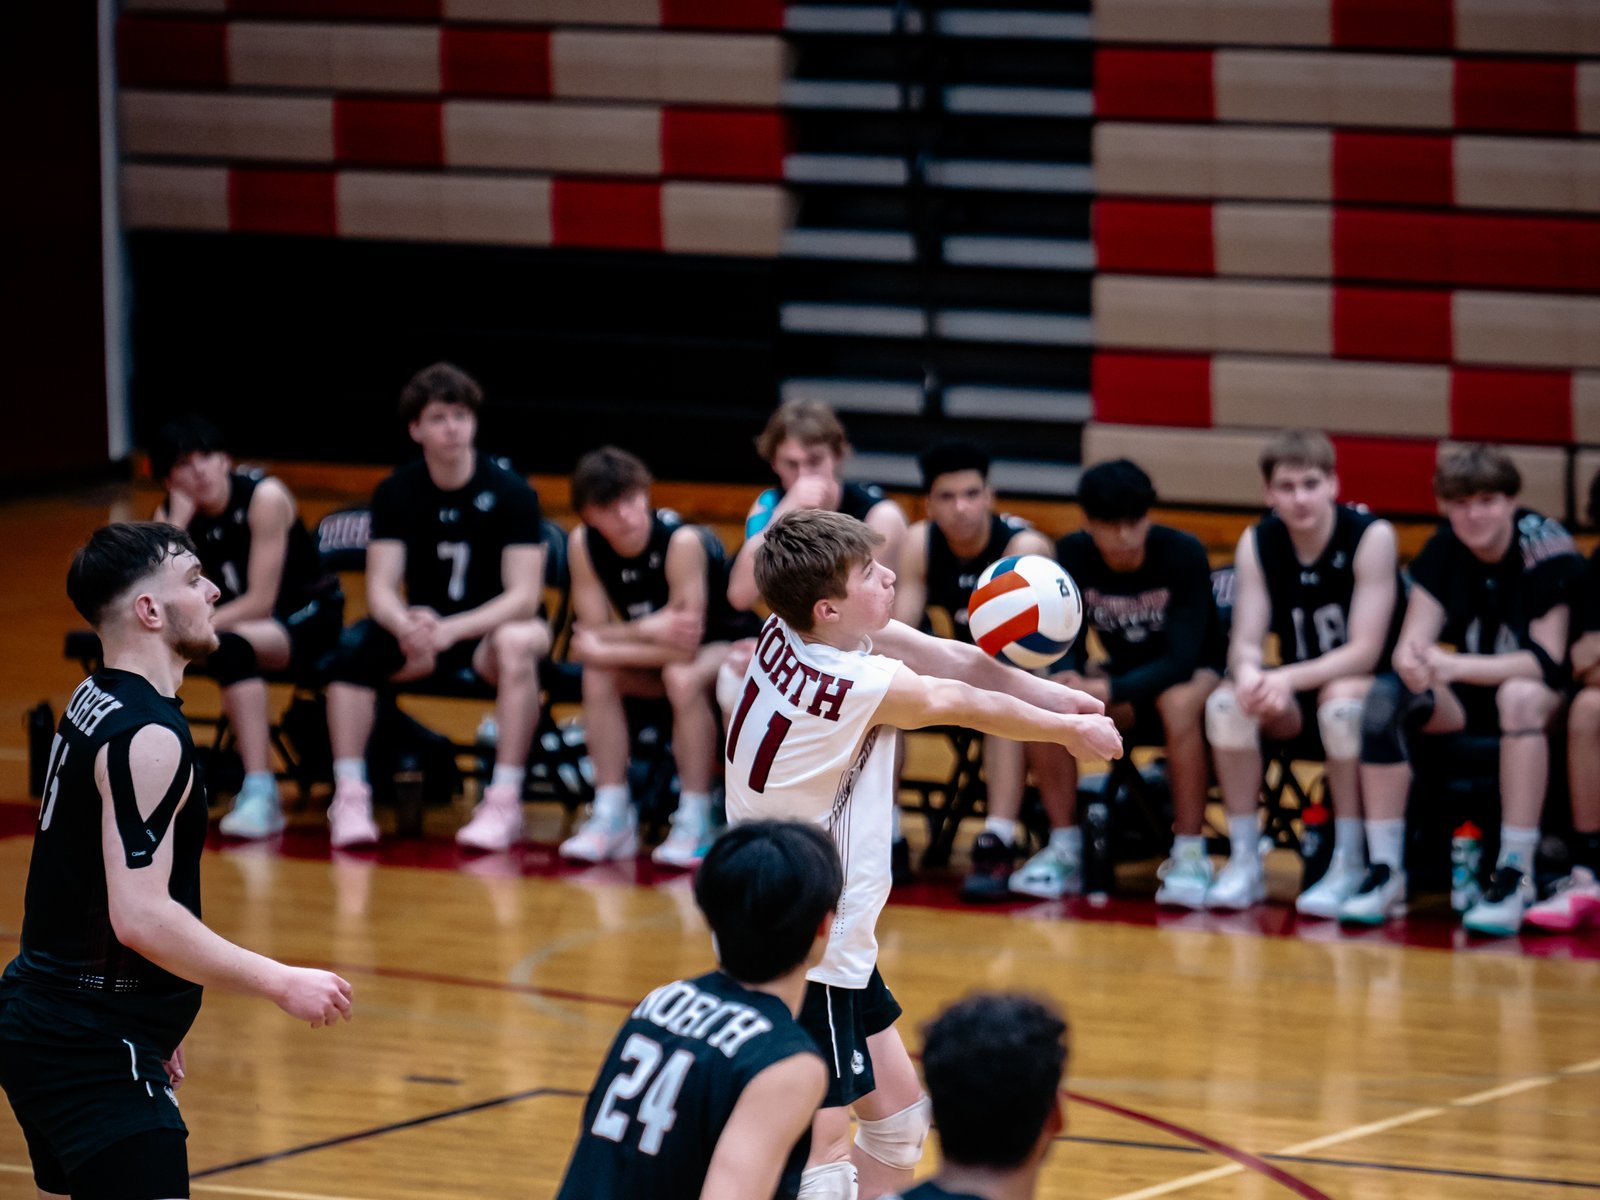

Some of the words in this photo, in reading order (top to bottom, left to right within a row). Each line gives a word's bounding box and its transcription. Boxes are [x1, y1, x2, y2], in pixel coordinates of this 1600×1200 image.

[437, 541, 469, 600] 7
[727, 676, 792, 794] 11
[591, 1033, 696, 1156] 24
